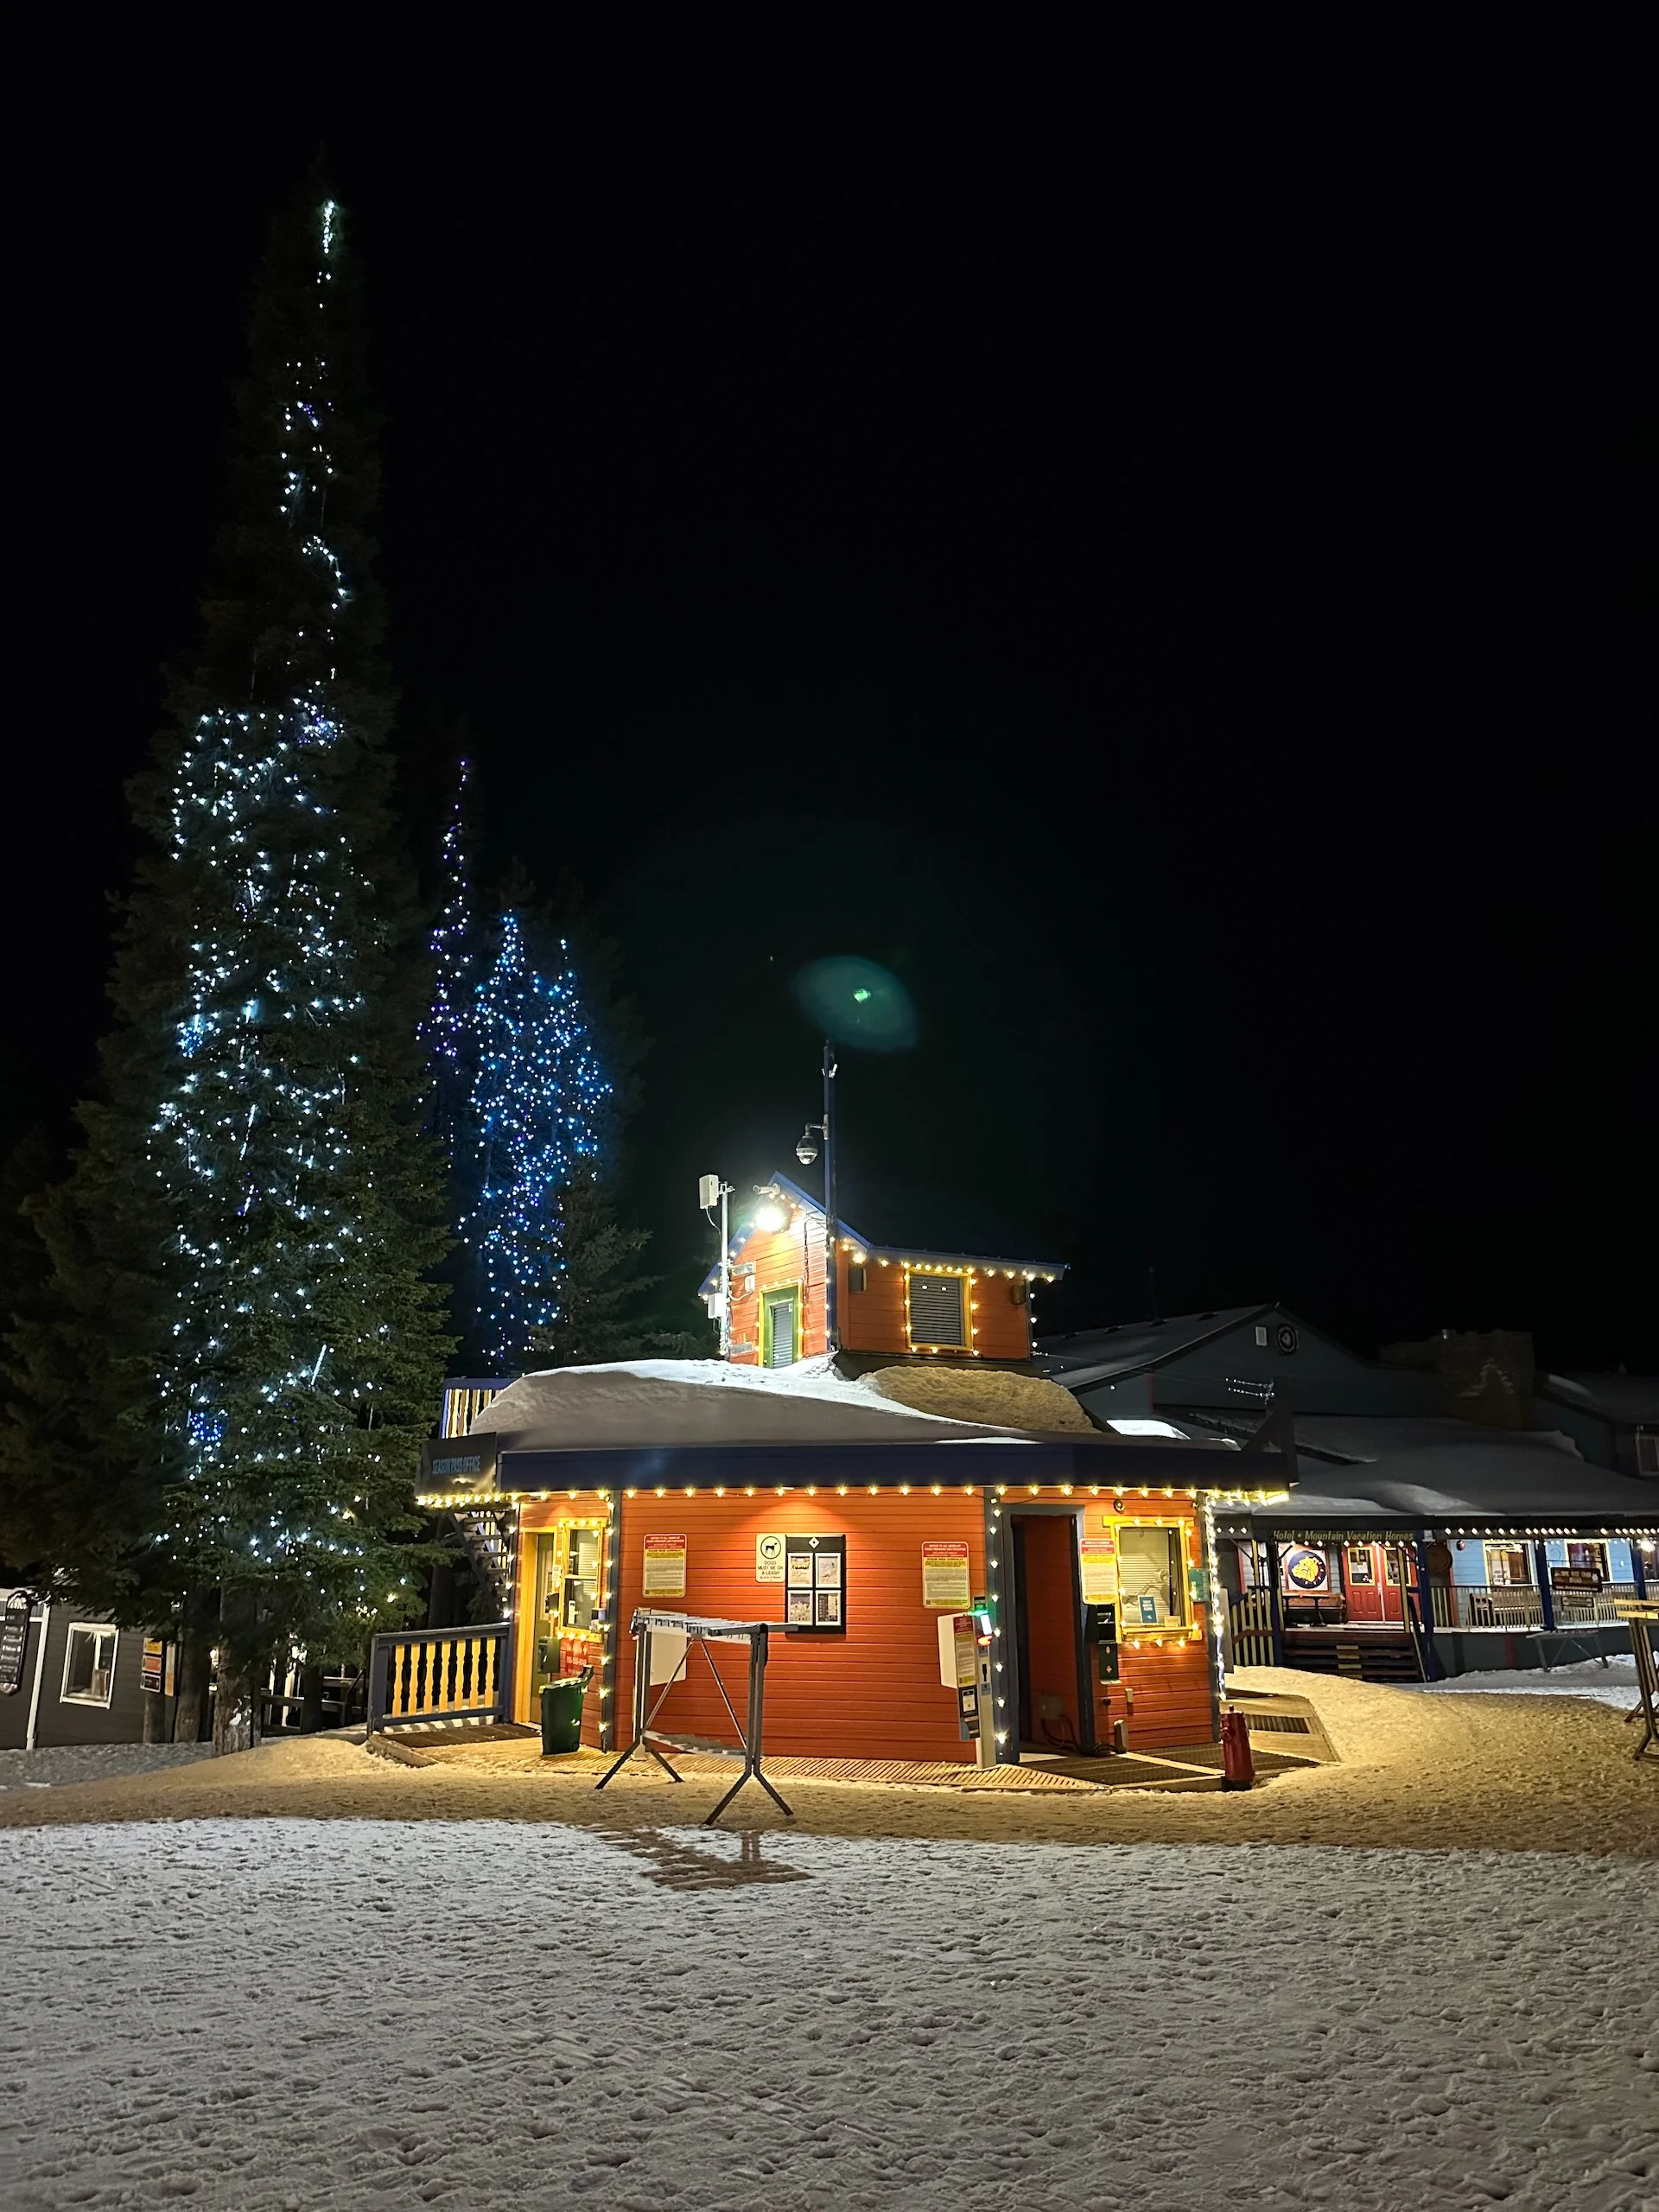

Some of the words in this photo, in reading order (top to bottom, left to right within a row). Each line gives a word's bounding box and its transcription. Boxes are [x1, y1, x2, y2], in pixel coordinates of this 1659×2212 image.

[432, 1459, 450, 1474] SEASON
[450, 1457, 463, 1473] PASS
[463, 1455, 480, 1472] OFFICE
[1273, 1530, 1294, 1541] Hotel
[1305, 1530, 1344, 1541] Mountain
[1346, 1530, 1382, 1541] Vacation
[1385, 1530, 1414, 1541] Homes
